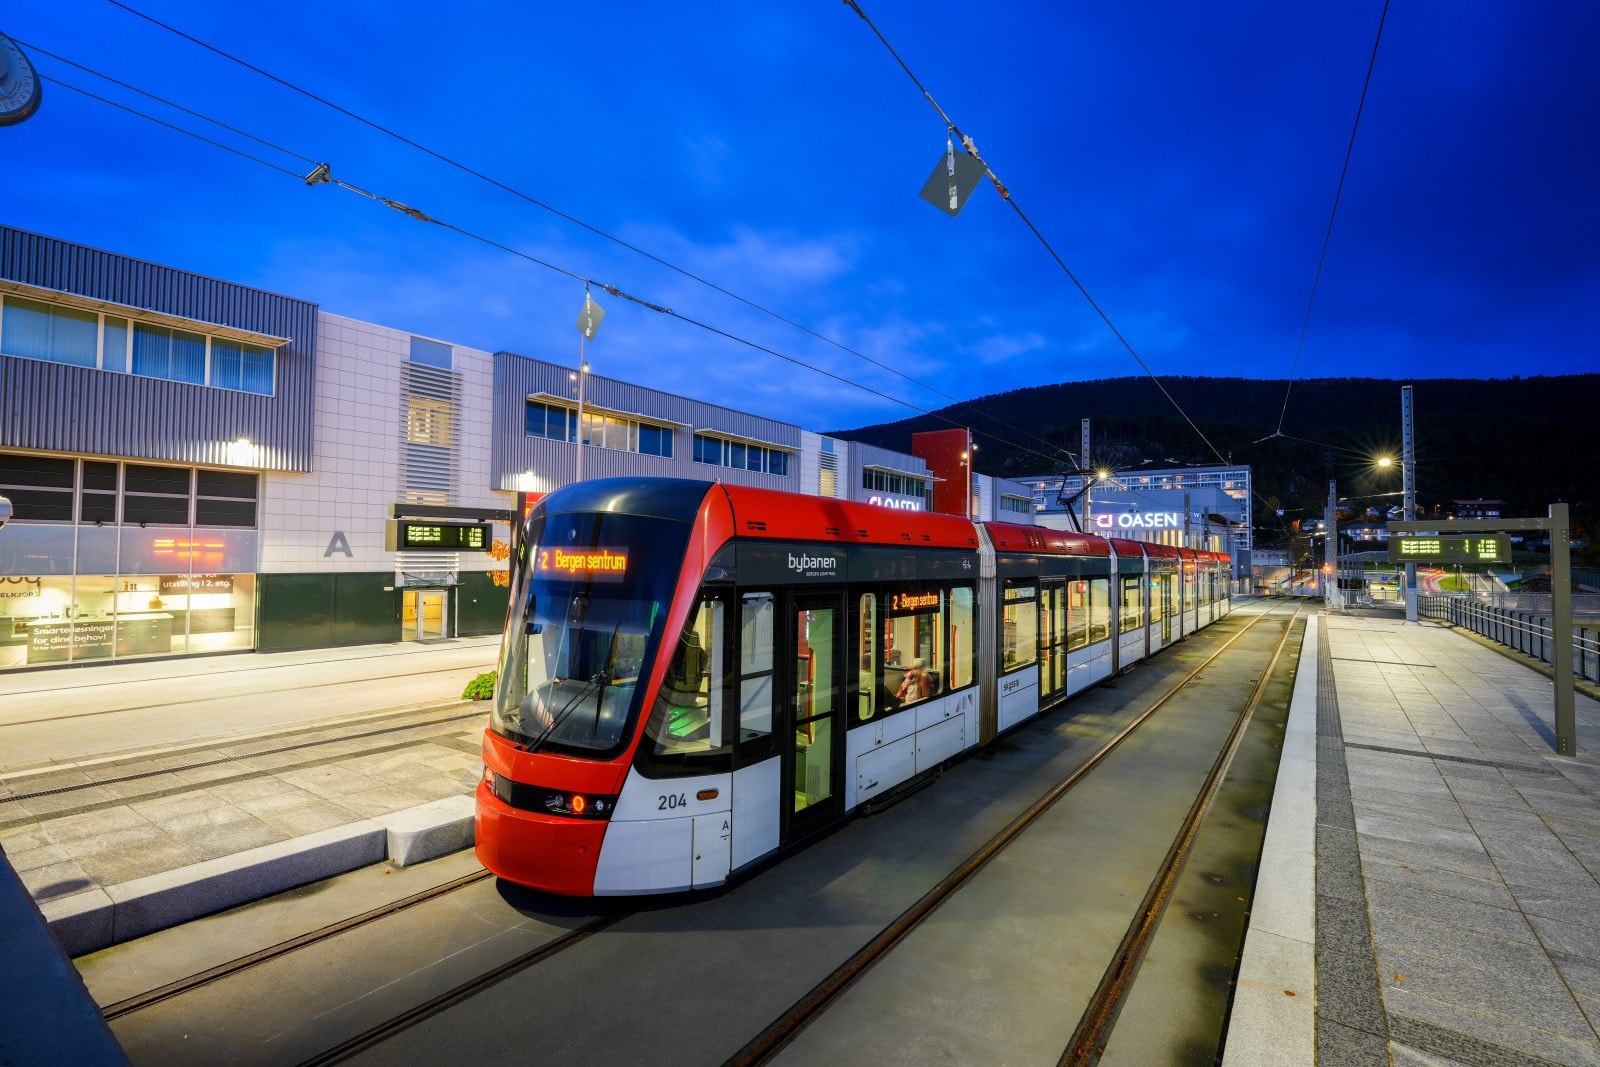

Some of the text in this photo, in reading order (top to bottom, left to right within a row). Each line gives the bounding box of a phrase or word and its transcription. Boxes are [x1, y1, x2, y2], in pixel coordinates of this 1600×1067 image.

[1118, 513, 1177, 527] OASEN
[323, 531, 353, 557] A
[542, 550, 626, 572] 2 Bergen sentrum
[788, 552, 836, 572] bybanen
[894, 592, 937, 610] 2 Bergen sentrum
[75, 634, 106, 642] behov!
[658, 793, 687, 810] 204
[722, 820, 729, 830] A
